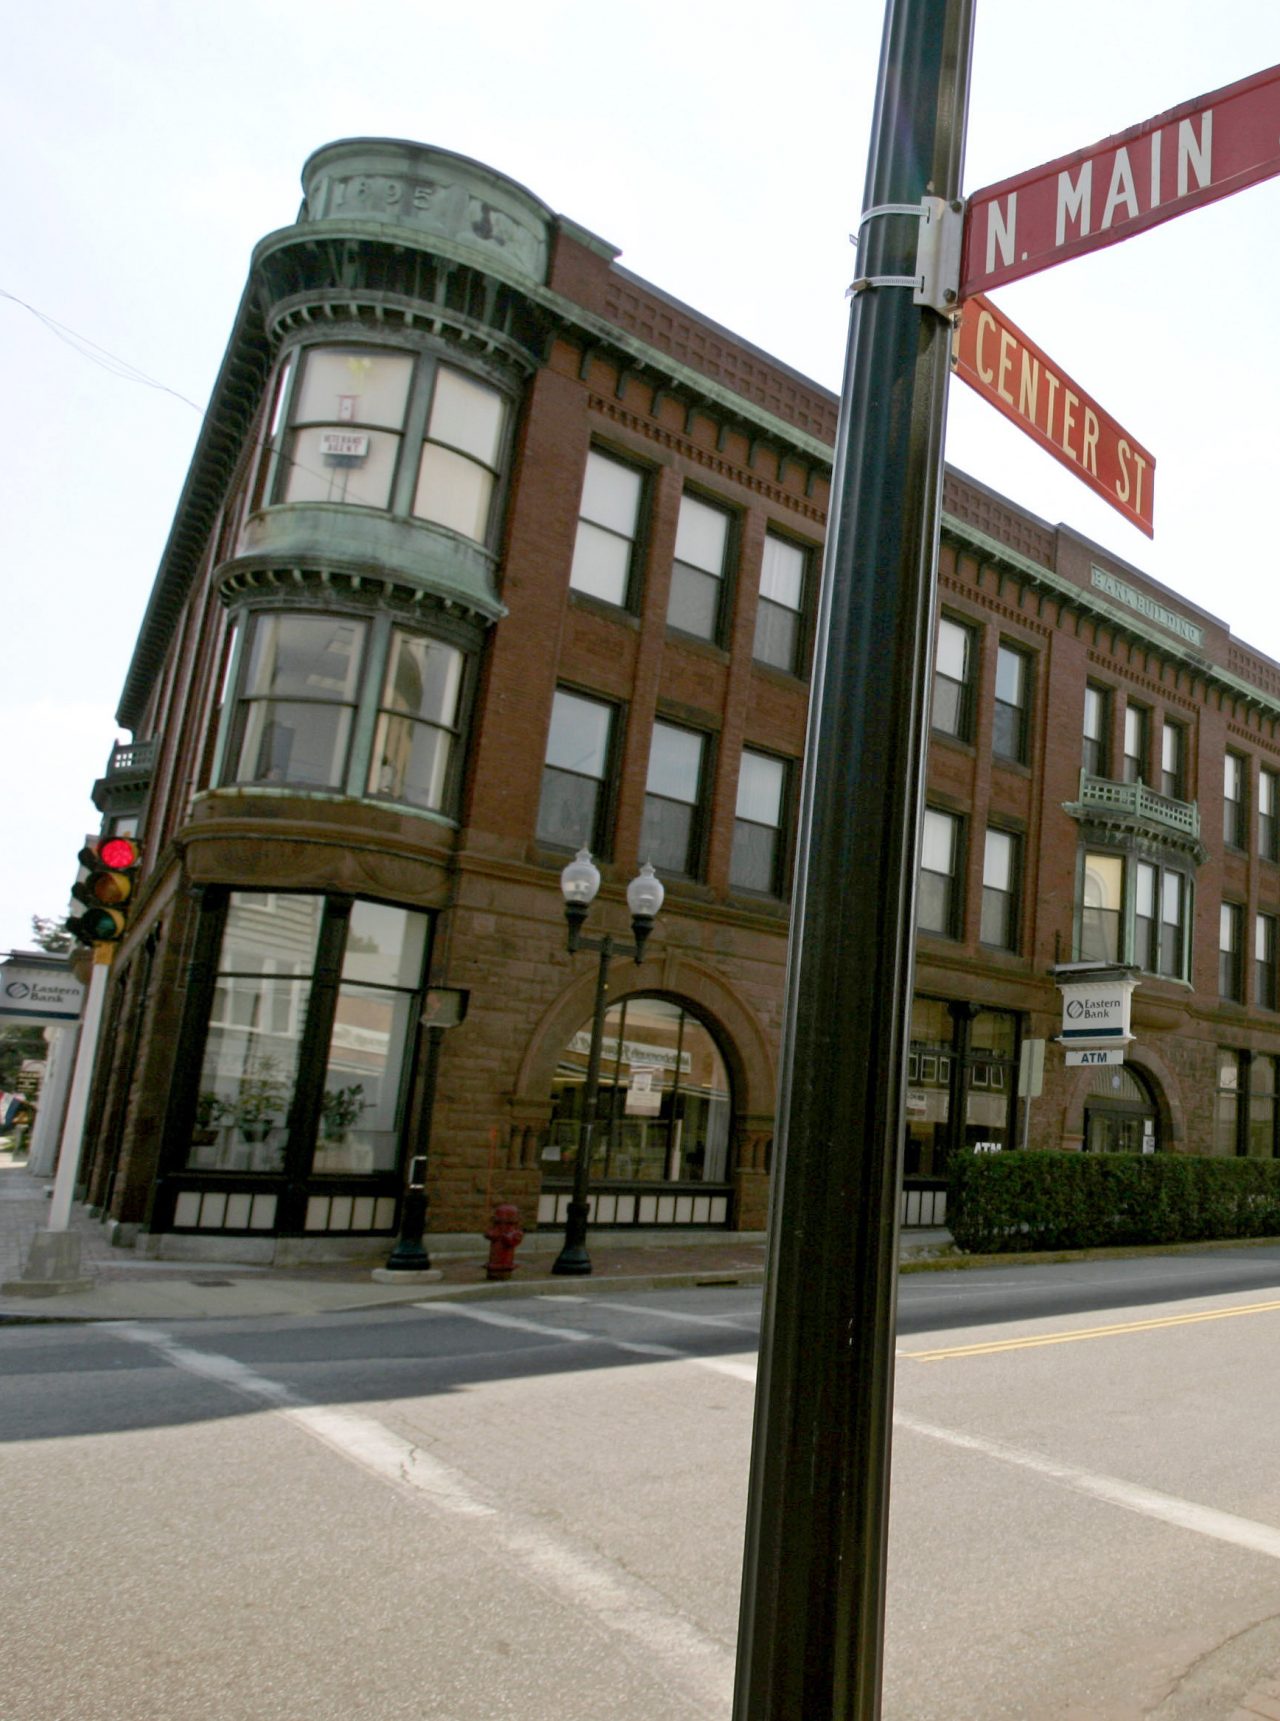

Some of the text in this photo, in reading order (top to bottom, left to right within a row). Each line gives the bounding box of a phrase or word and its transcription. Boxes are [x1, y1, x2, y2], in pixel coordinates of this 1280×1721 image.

[984, 191, 1029, 275] N.
[1054, 109, 1214, 248] MAIN
[975, 309, 1147, 515] CENTER ST
[1094, 568, 1133, 606] BANK
[31, 983, 80, 996] Eastern
[30, 992, 64, 1003] Bank
[1084, 999, 1121, 1009] Eastern
[1084, 1009, 1110, 1019] Bank
[1080, 1052, 1108, 1064] ATM
[973, 1141, 1003, 1155] ATM
